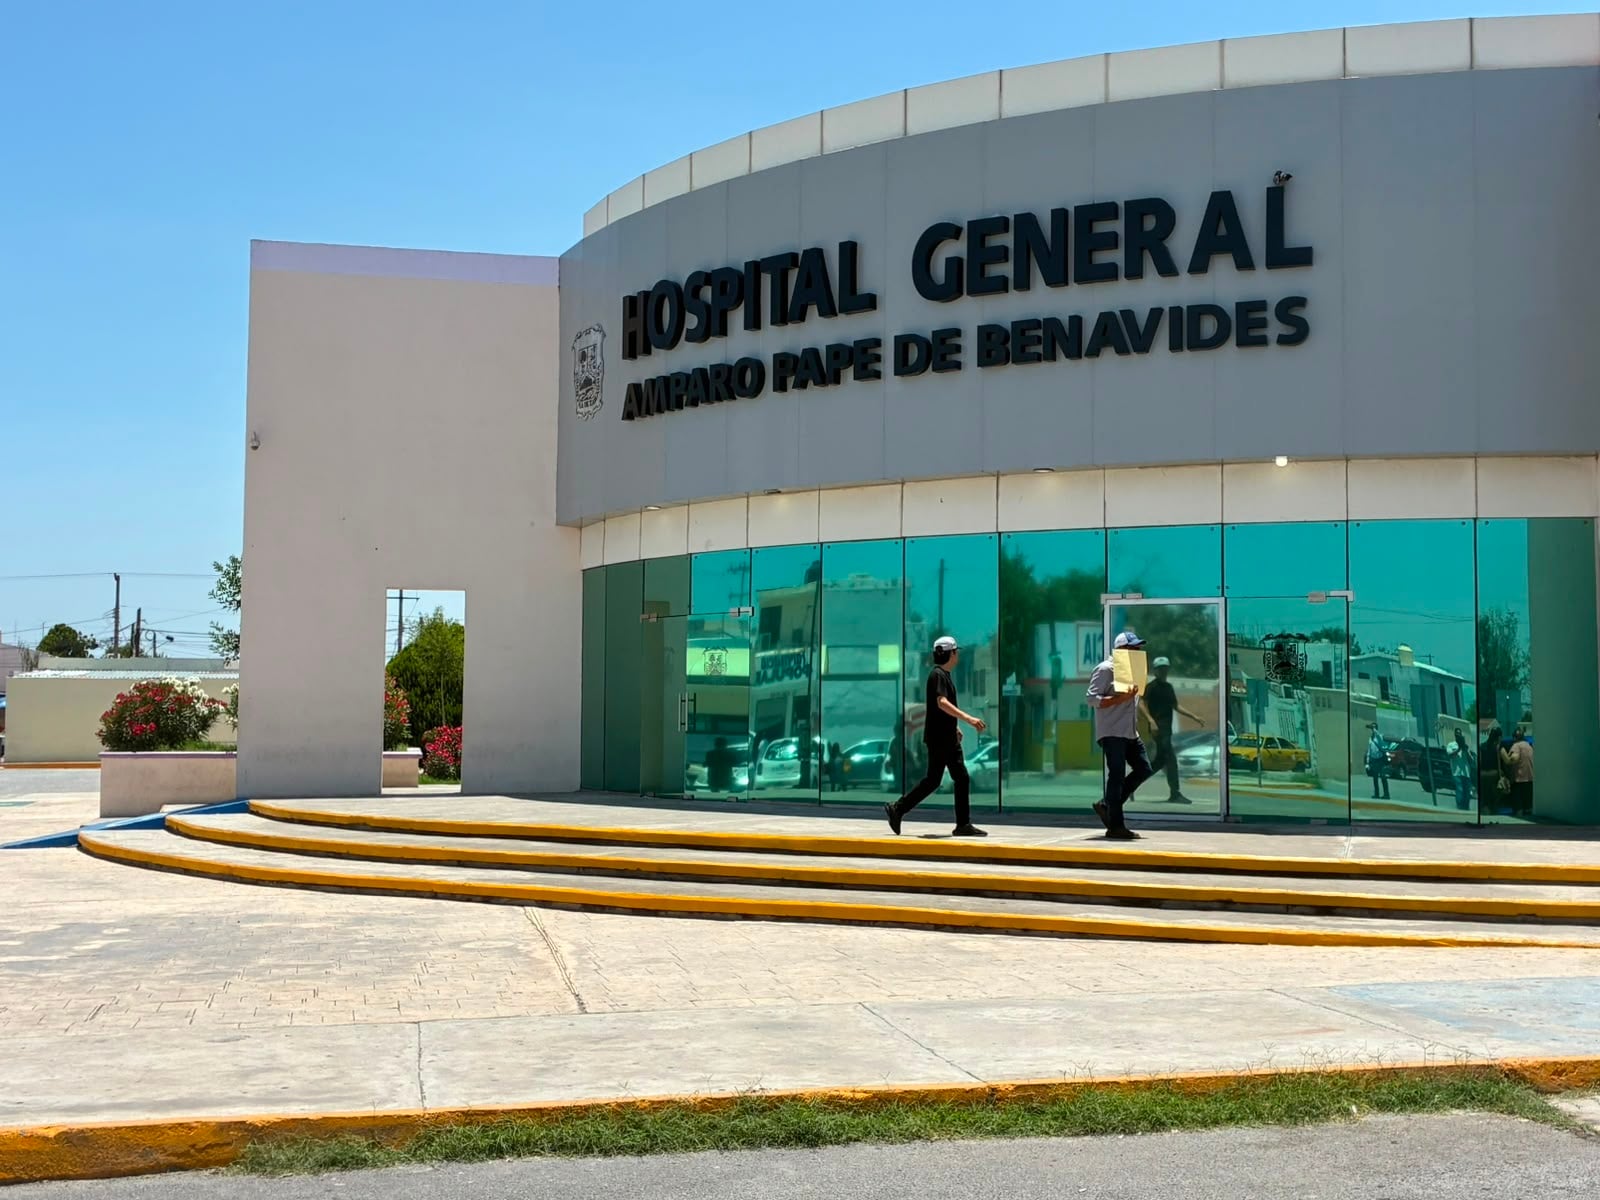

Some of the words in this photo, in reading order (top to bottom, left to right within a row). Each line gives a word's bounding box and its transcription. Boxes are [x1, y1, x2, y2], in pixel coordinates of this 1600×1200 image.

[622, 240, 877, 360] HOSPITAL
[912, 185, 1313, 303] GENERAL
[621, 356, 766, 421] AMPARO
[772, 337, 881, 393] PAPE
[893, 327, 962, 377] DE
[977, 296, 1309, 368] BENAVIDES
